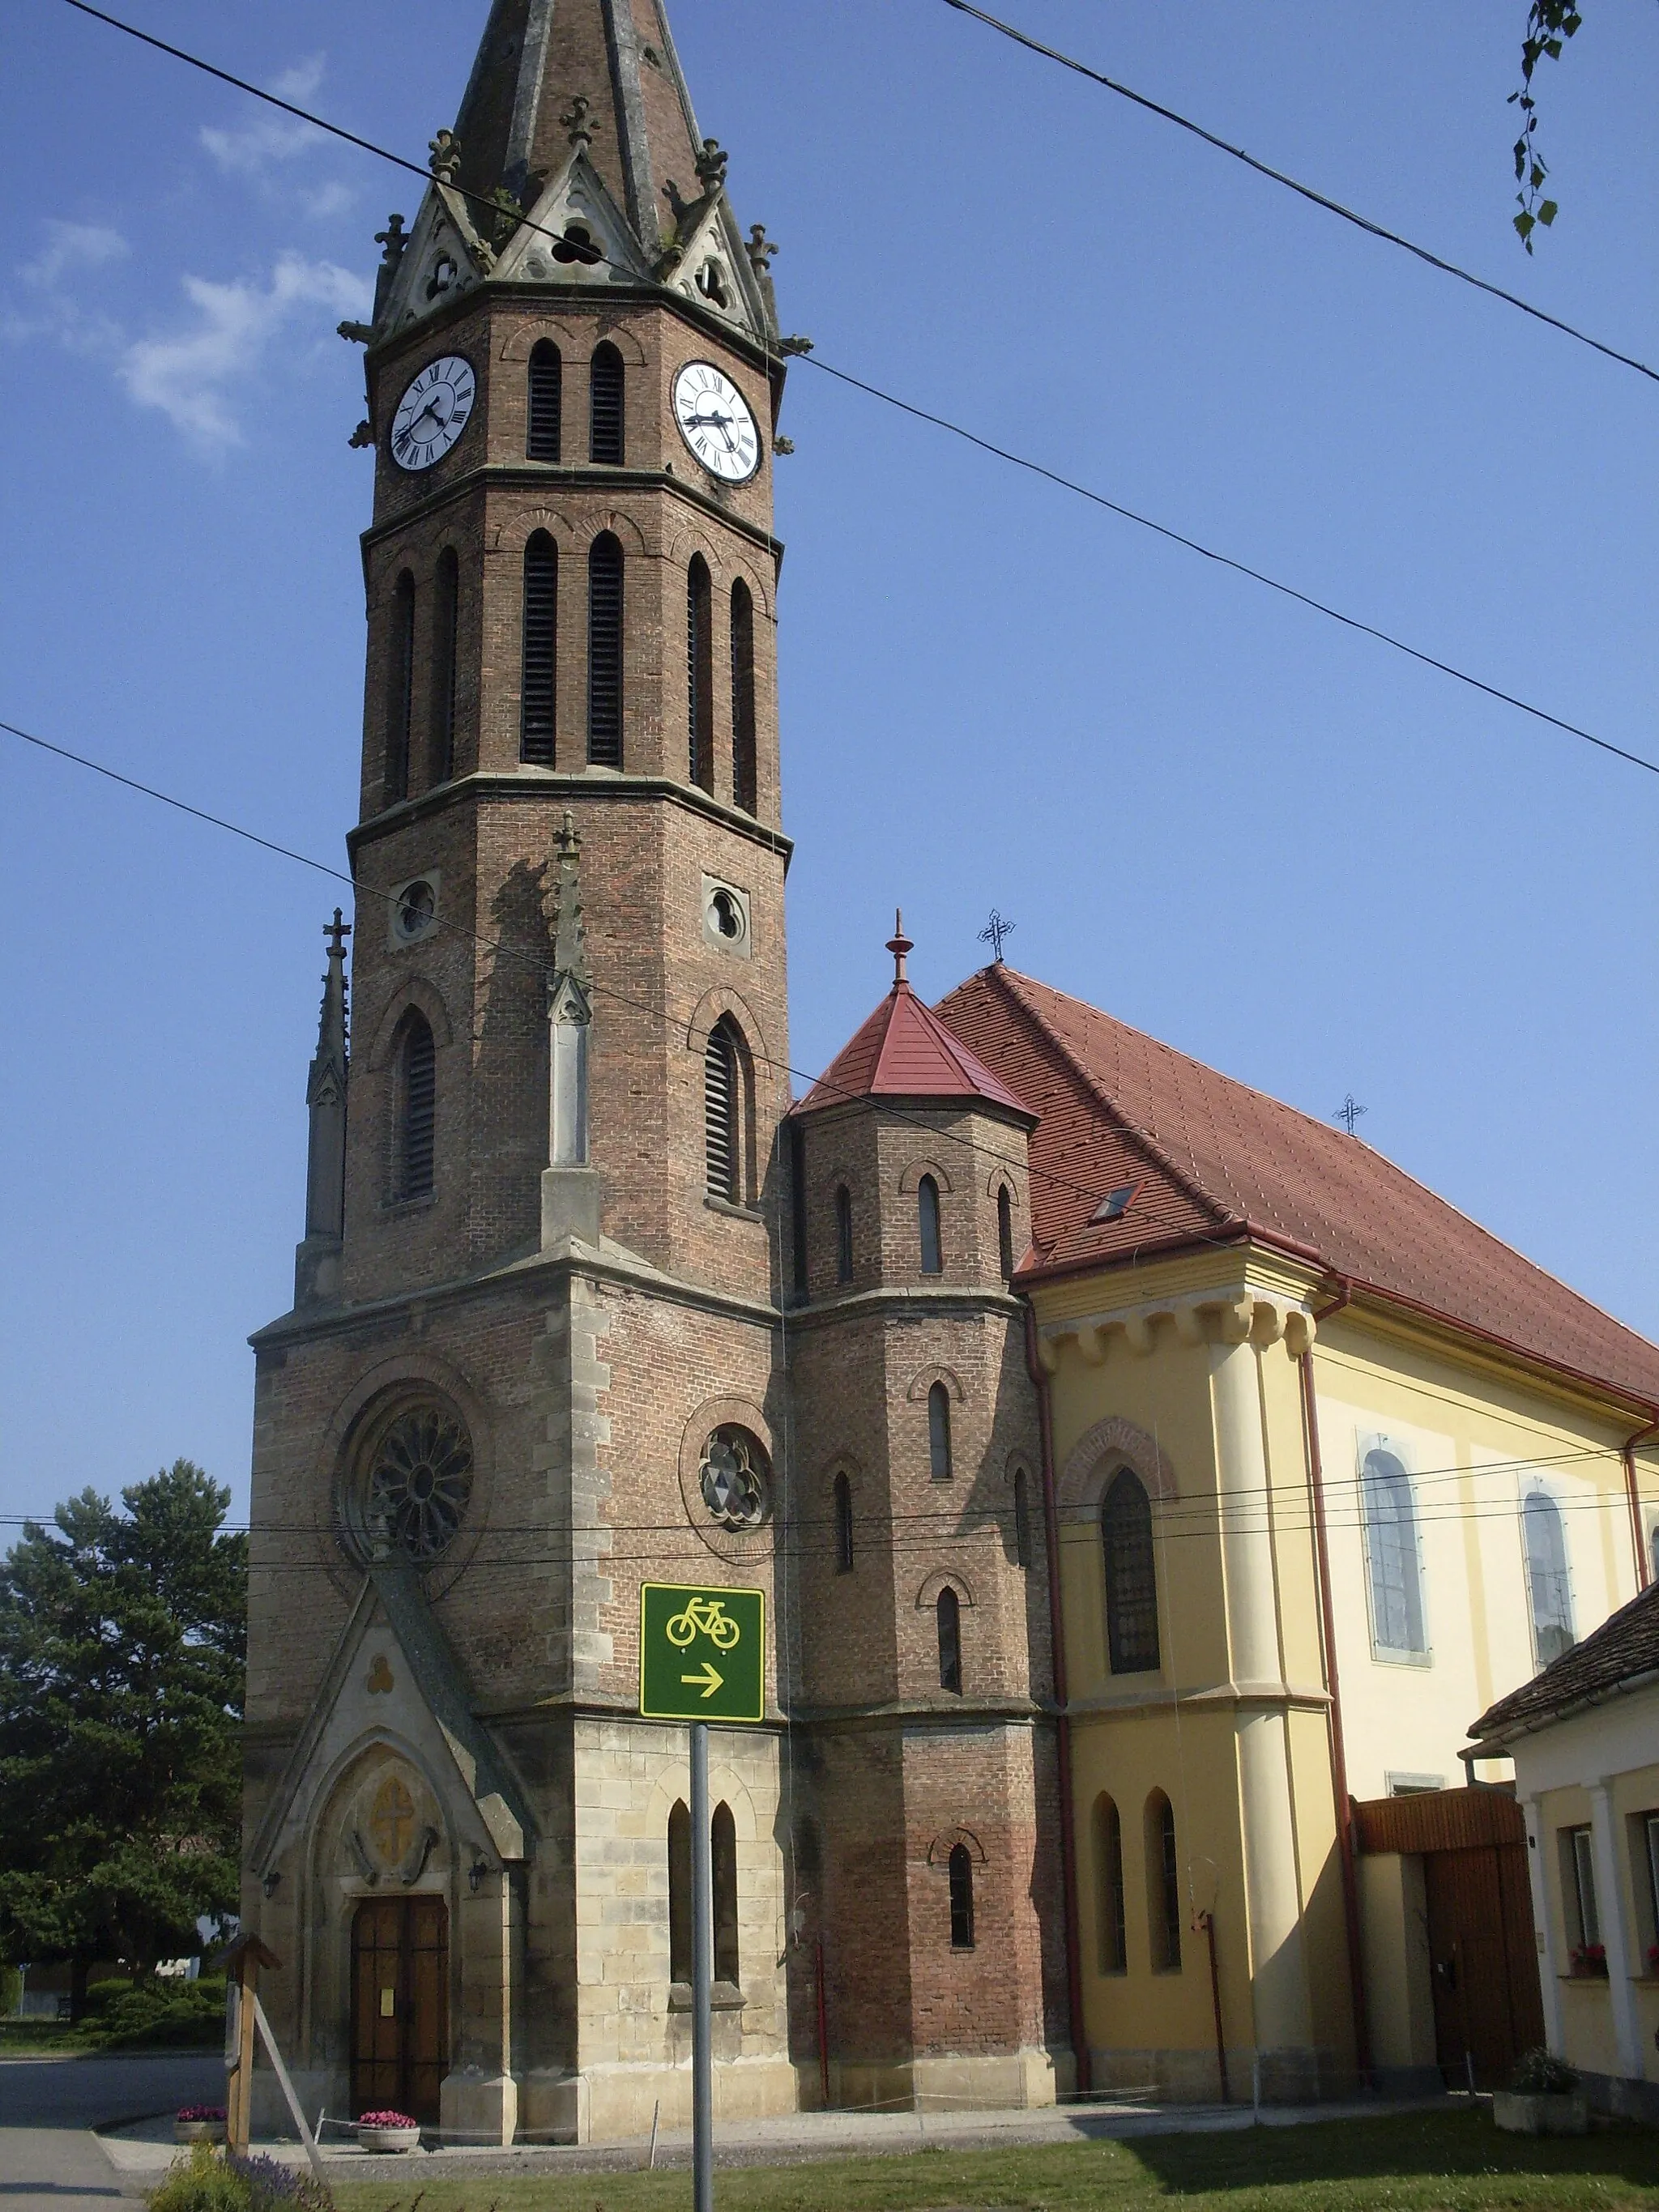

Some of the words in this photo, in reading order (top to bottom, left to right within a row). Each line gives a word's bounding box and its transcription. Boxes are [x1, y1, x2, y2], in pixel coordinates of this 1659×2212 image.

[446, 361, 454, 380] I
[454, 369, 468, 386] II
[712, 373, 722, 394] XII
[457, 387, 471, 402] III
[729, 394, 736, 403] I
[400, 405, 413, 414] X
[451, 411, 467, 424] IIII
[695, 436, 707, 455] VII
[741, 435, 753, 449] III
